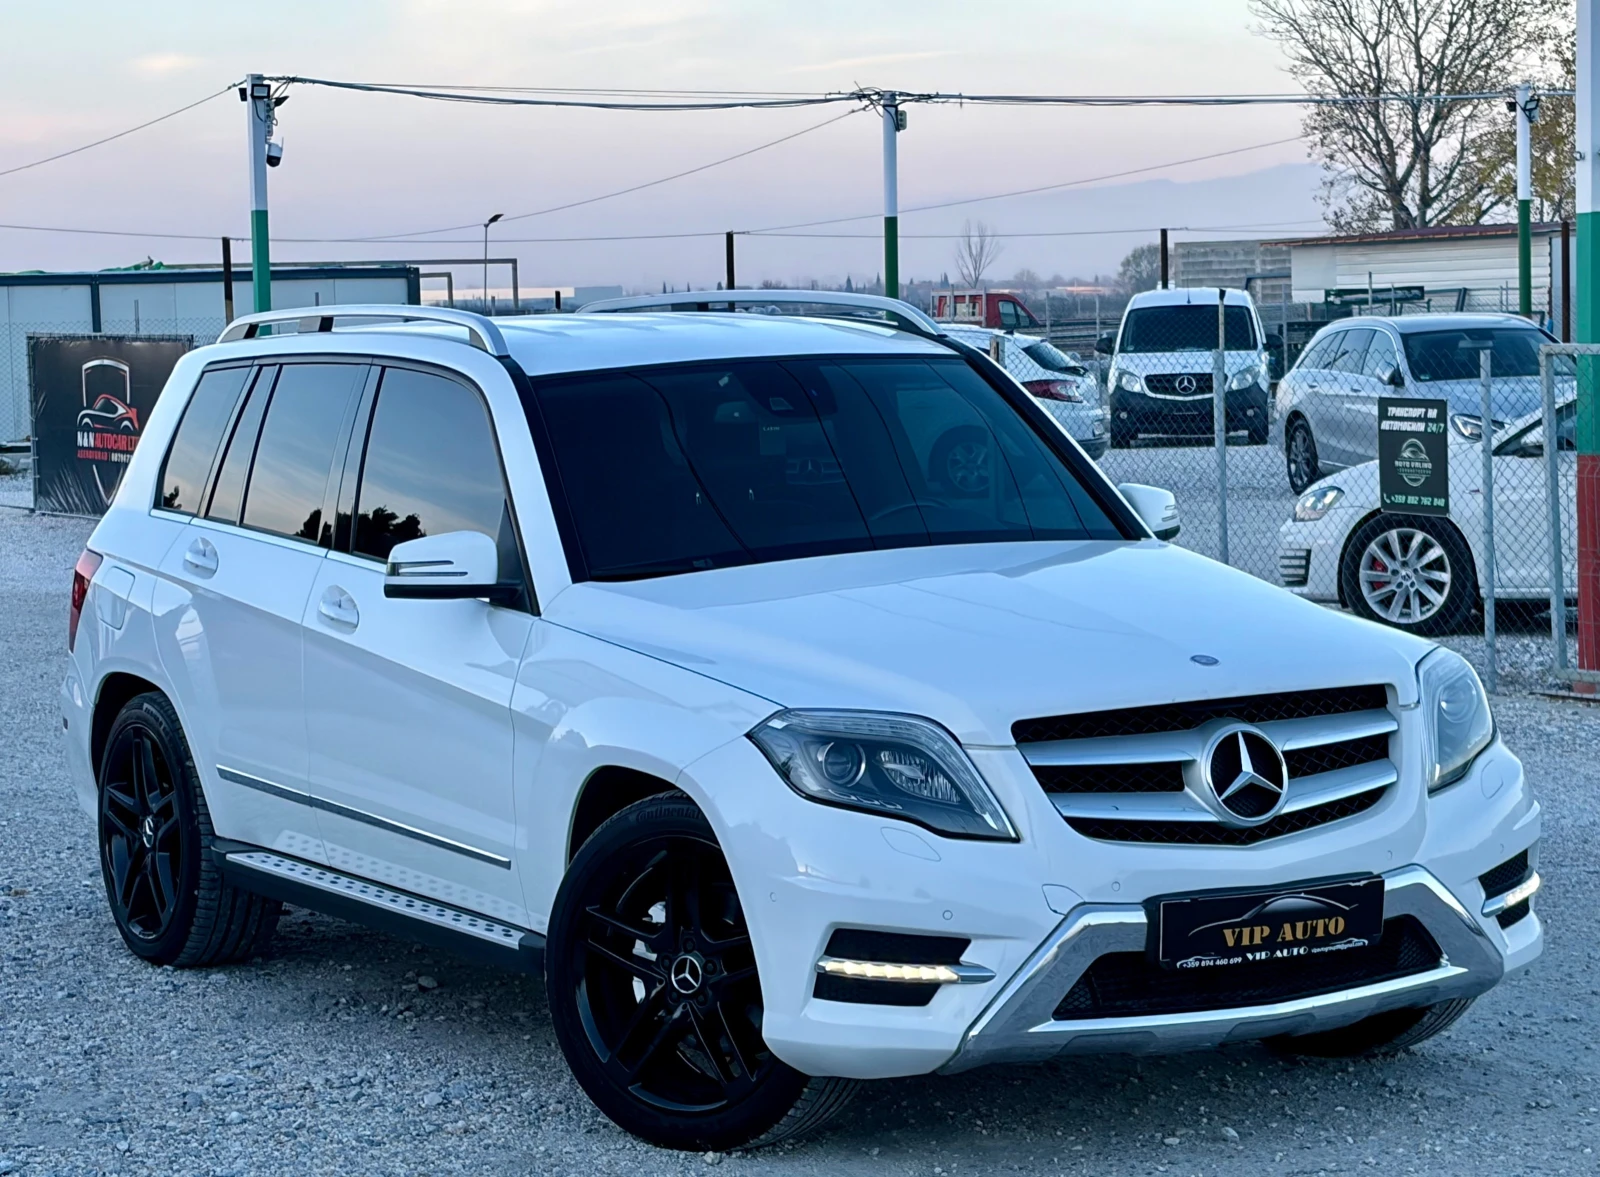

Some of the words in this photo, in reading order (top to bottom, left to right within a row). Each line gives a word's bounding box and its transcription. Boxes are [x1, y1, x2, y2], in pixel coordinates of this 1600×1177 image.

[1427, 422, 1444, 434] 24/7
[77, 431, 94, 448] N&N
[95, 433, 128, 450] AUTOCAR
[1223, 925, 1271, 947] VIP
[1277, 916, 1345, 942] AUTO
[1246, 951, 1270, 961] VIP
[1273, 946, 1308, 958] AUTO
